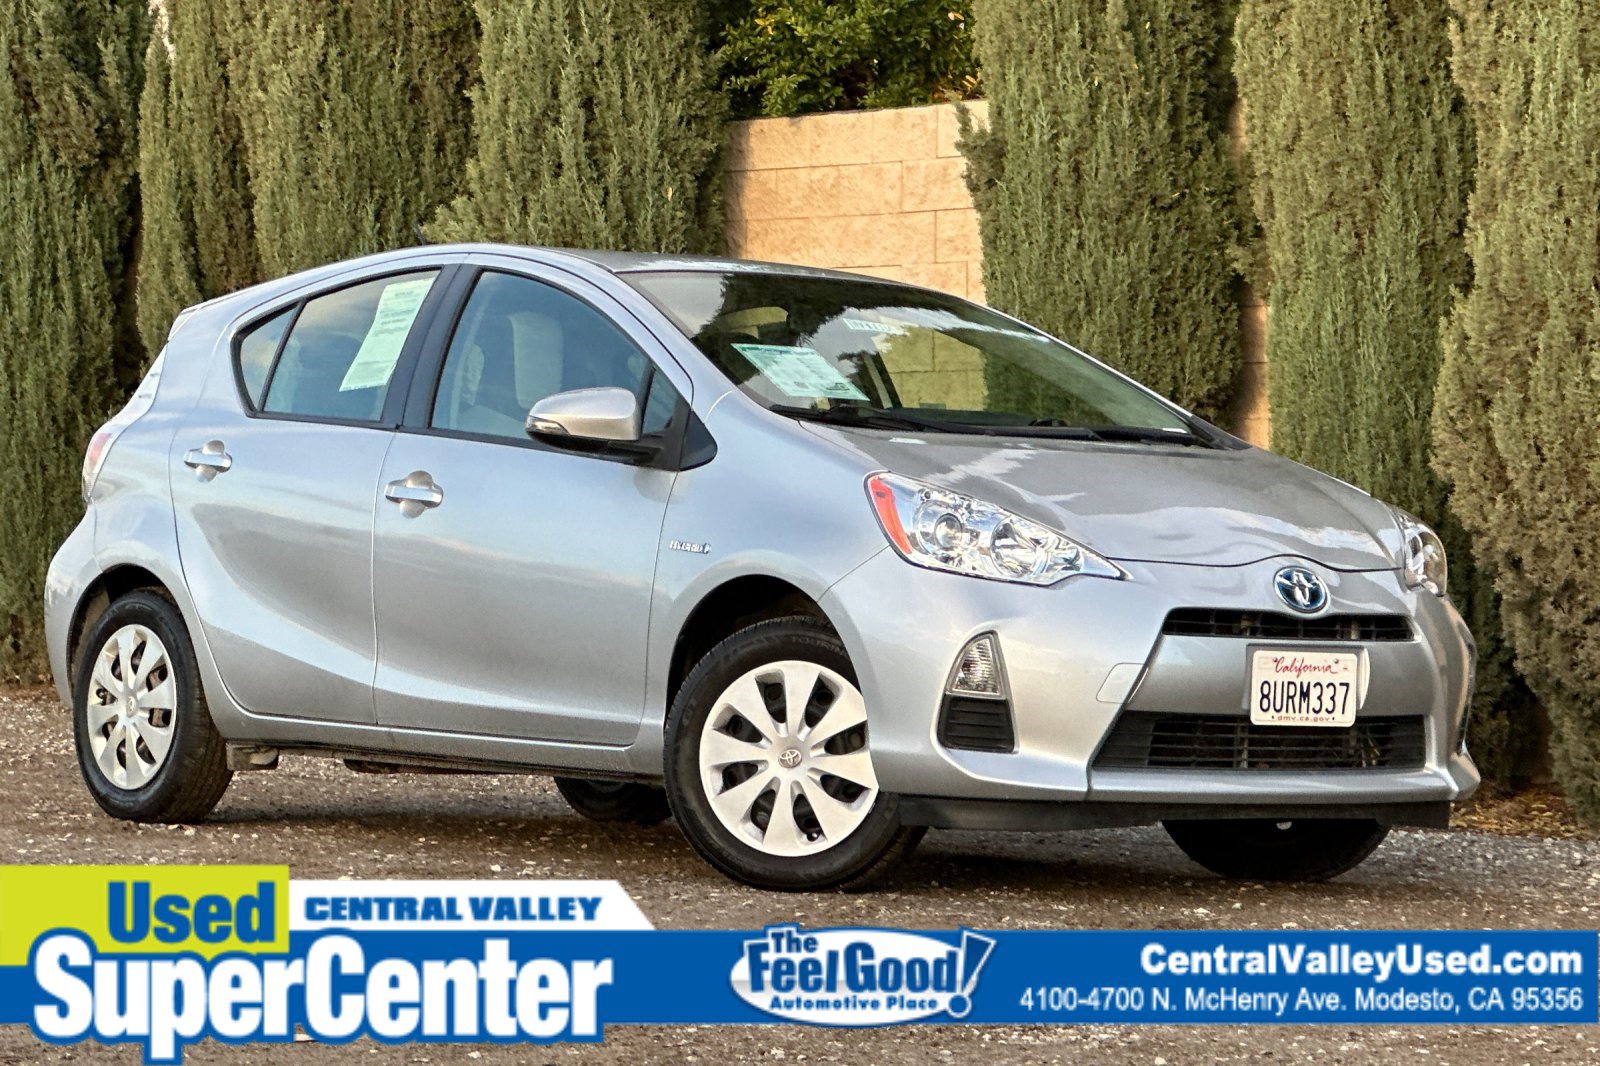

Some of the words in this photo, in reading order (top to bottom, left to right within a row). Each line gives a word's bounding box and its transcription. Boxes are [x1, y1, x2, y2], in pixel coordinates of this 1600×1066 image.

[1275, 656, 1338, 679] California
[1259, 680, 1350, 715] 8URM337
[1277, 714, 1330, 722] dmv.ca.gov
